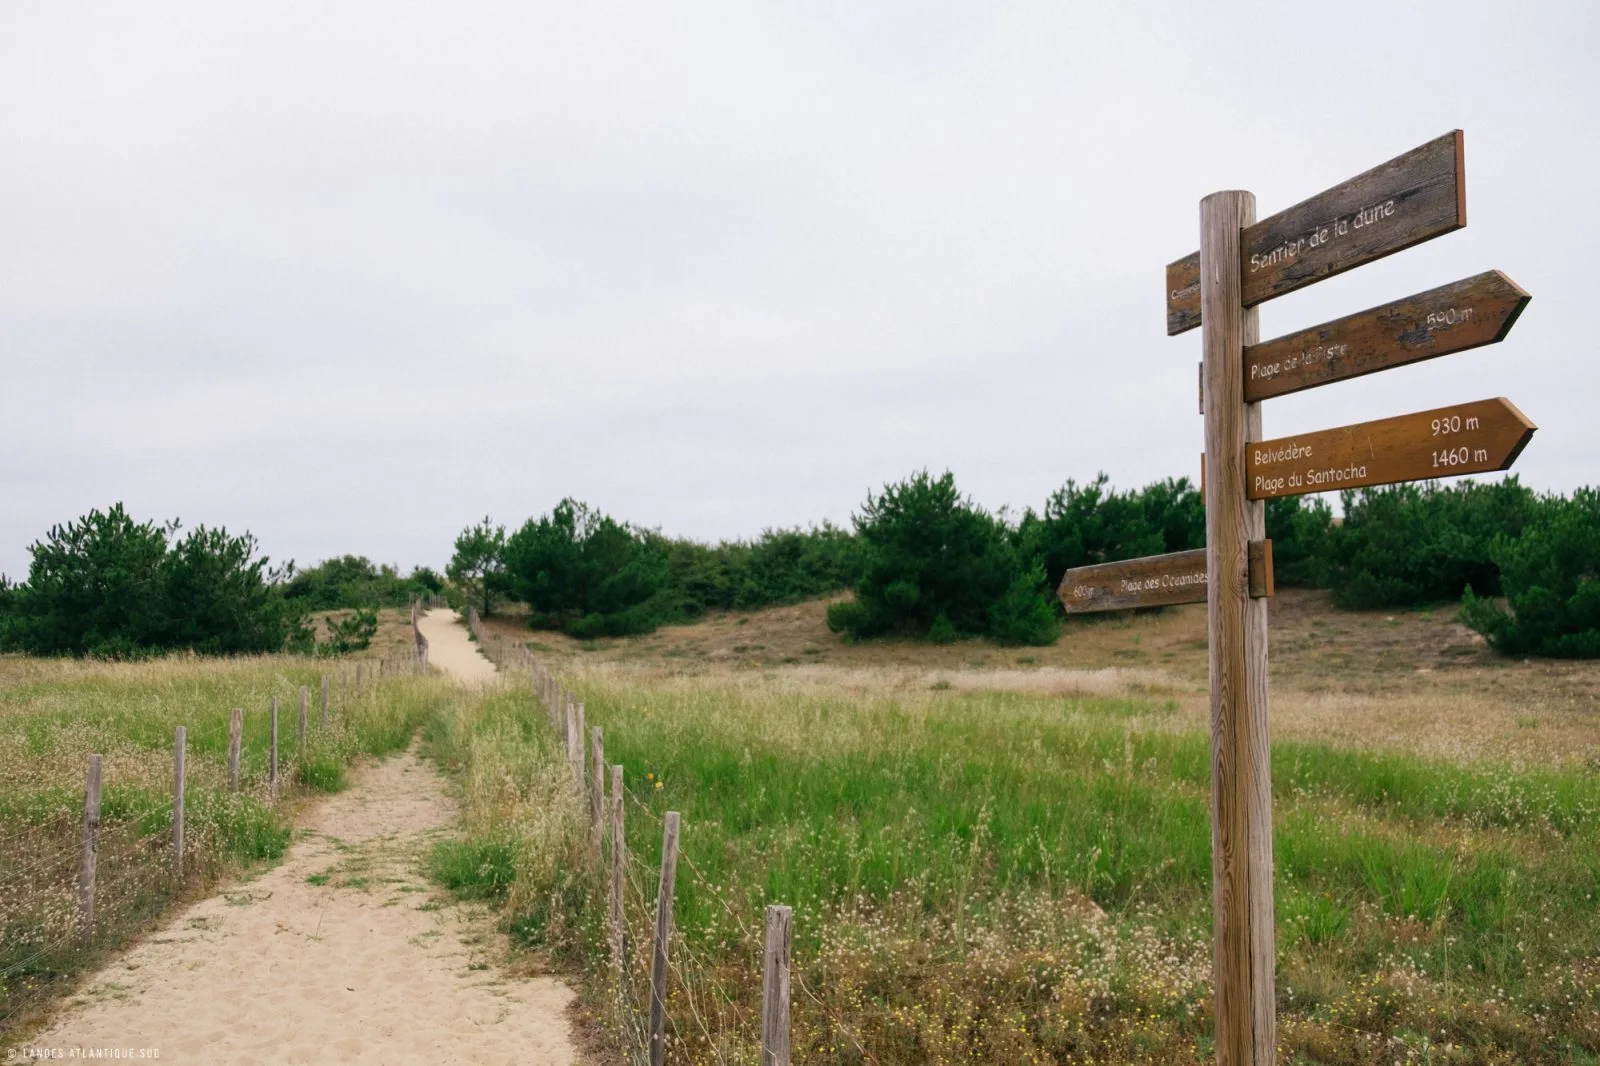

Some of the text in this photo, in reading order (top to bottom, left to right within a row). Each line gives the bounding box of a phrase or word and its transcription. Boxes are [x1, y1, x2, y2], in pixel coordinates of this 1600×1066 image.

[1250, 200, 1395, 273] Sentier de la dune
[1251, 362, 1280, 380] Plage
[1284, 354, 1297, 371] de
[1461, 308, 1473, 321] m
[1254, 415, 1480, 466] Belvédère 930 m
[1254, 446, 1488, 495] Plage du Santocha 1460 m
[1120, 579, 1142, 595] Plage
[1144, 576, 1160, 590] des
